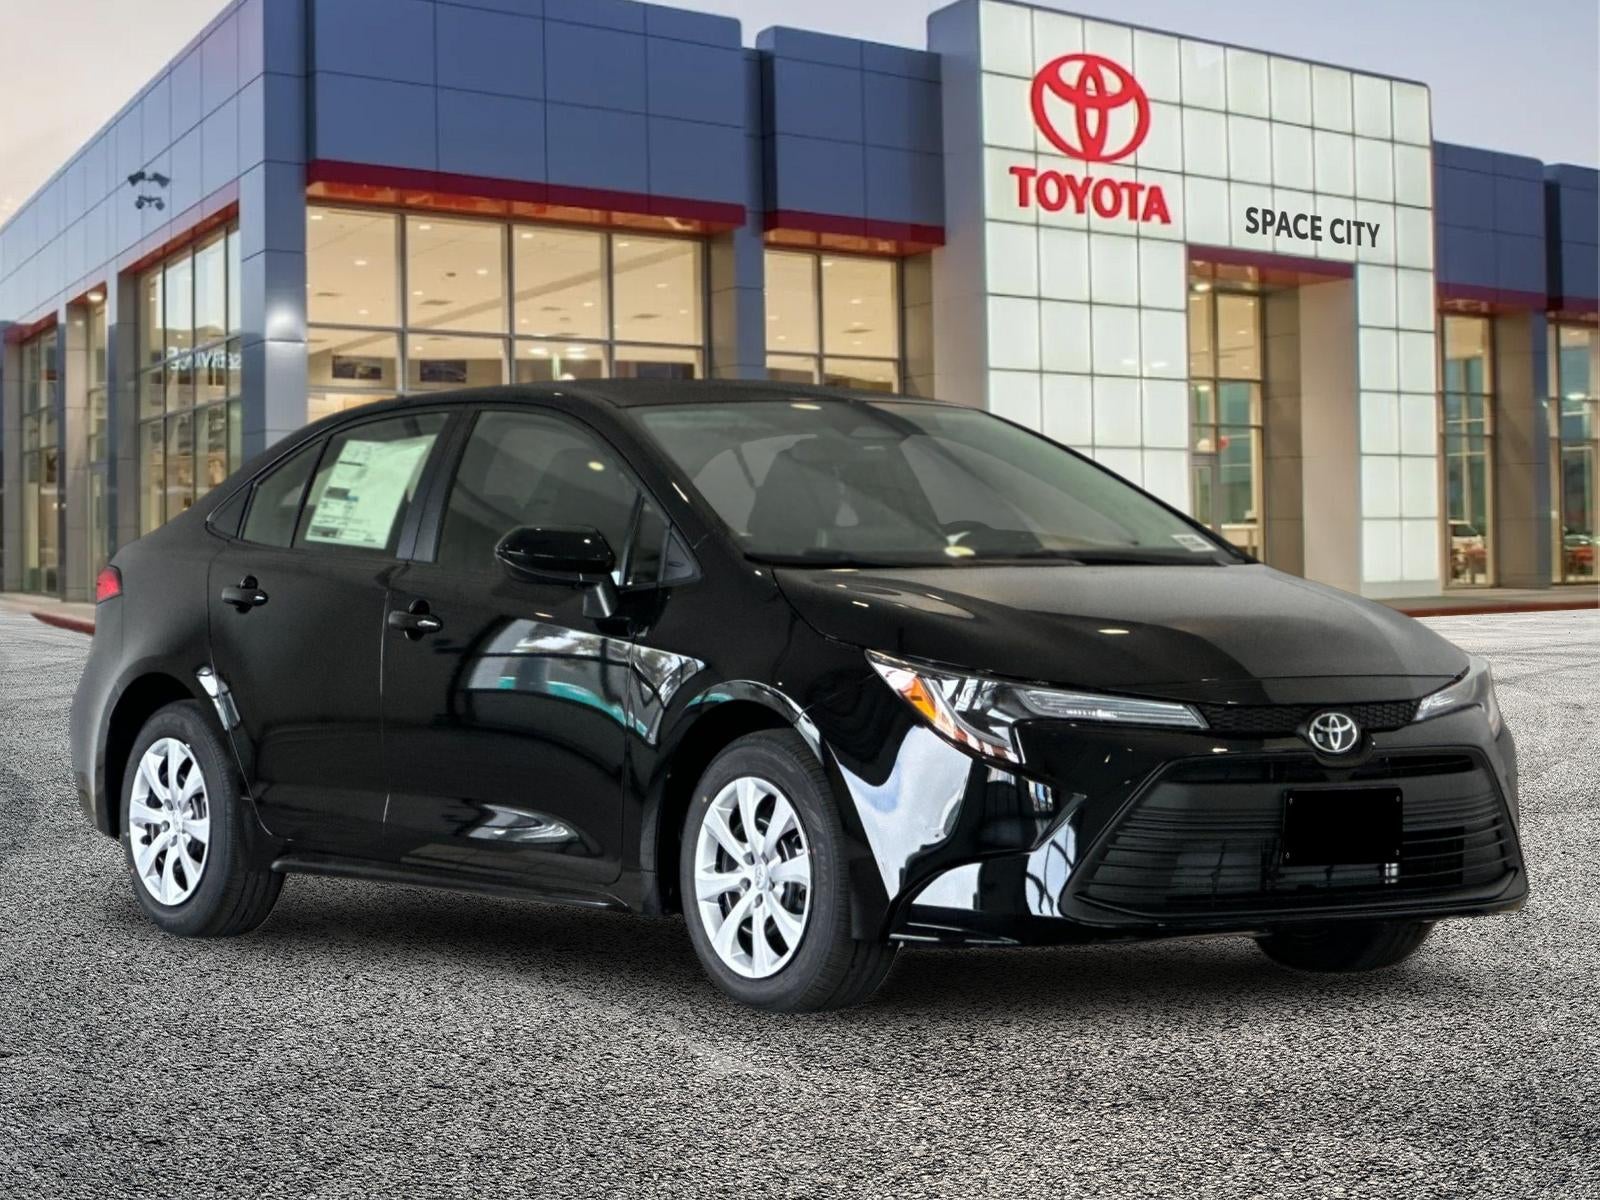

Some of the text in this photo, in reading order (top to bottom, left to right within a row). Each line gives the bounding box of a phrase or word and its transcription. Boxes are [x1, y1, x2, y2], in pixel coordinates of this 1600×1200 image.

[1009, 166, 1171, 224] TOYOTA
[1245, 206, 1380, 247] SPACE CITY
